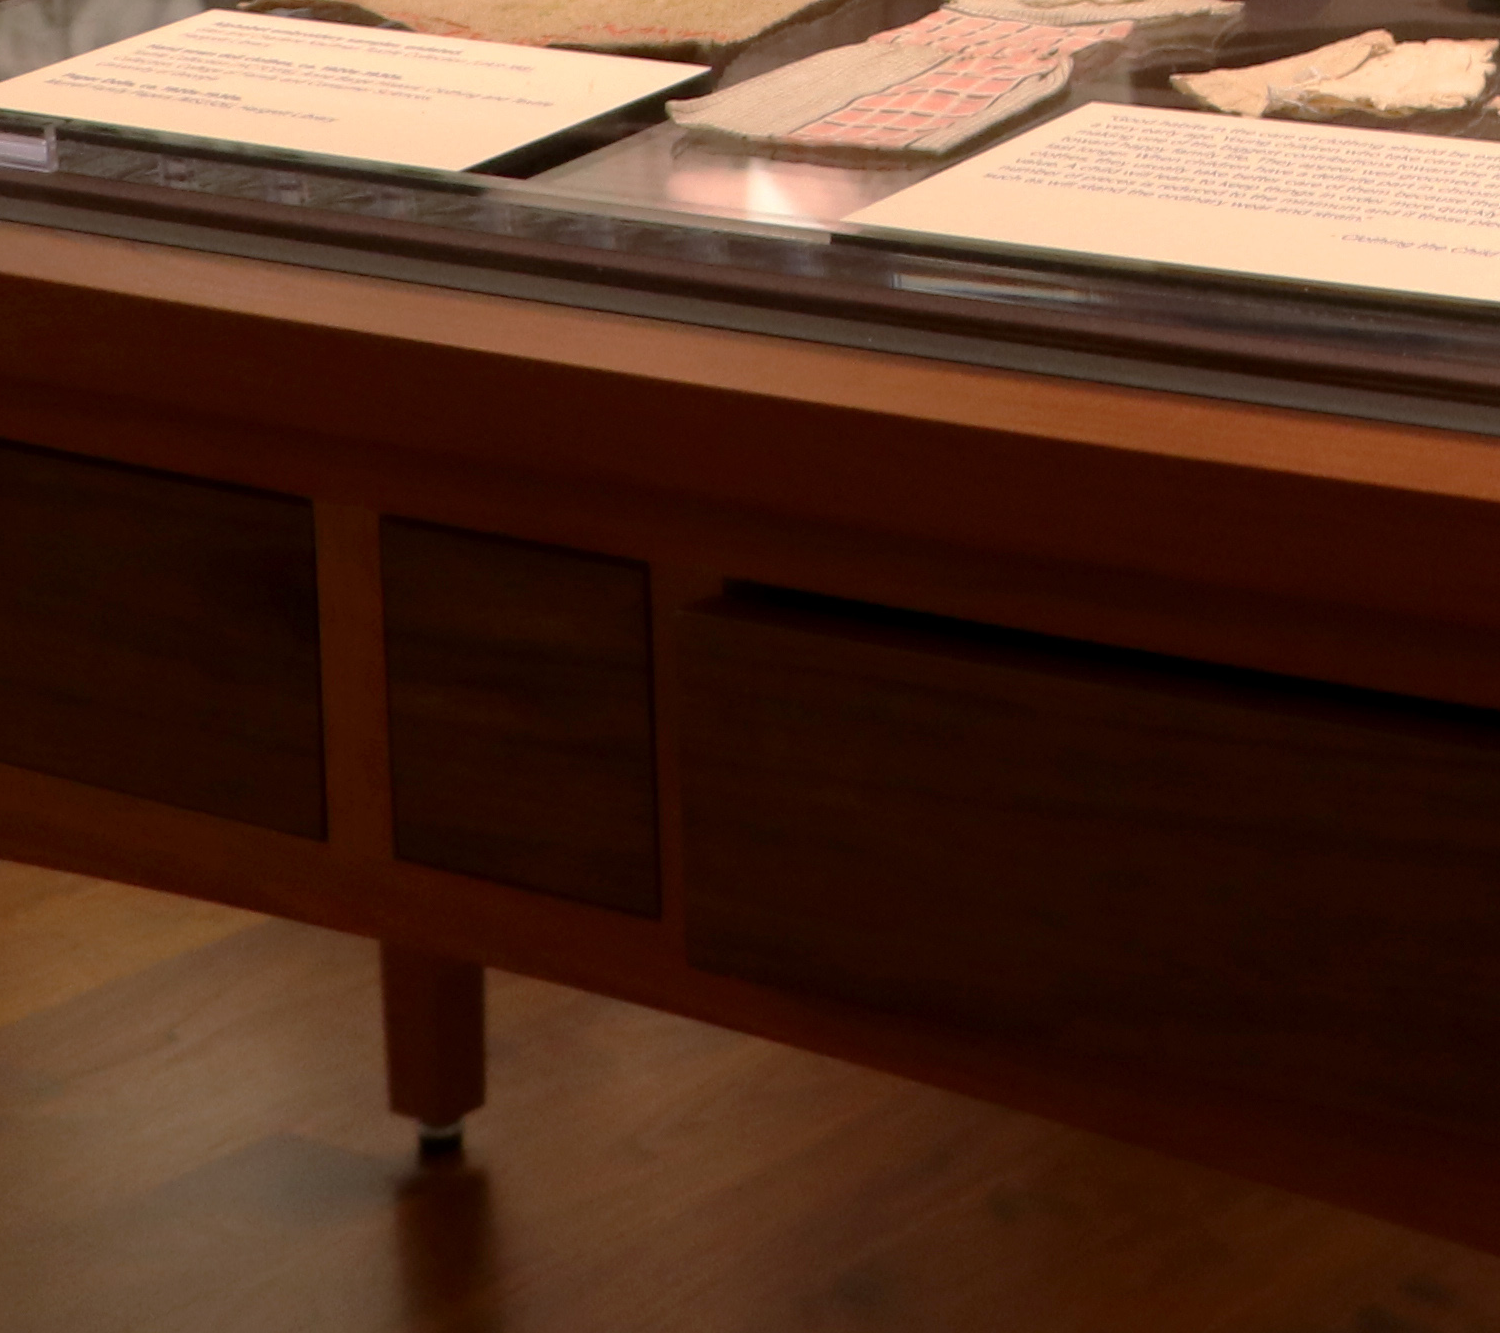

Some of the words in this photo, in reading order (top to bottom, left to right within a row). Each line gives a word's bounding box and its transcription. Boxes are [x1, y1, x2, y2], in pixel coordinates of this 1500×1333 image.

[1105, 123, 1134, 132] very
[1141, 128, 1177, 136] early
[1223, 135, 1271, 146] Young
[1274, 142, 1340, 153] children
[1384, 152, 1415, 161] take
[1423, 158, 1461, 166] care
[1159, 120, 1206, 130] habits
[1318, 138, 1384, 149] clothing
[1390, 145, 1446, 155] should
[983, 172, 1021, 181] such
[1047, 180, 1077, 188] will
[1077, 184, 1126, 194] stand
[1157, 193, 1225, 206] ordinary
[1231, 201, 1272, 210] wear
[1341, 234, 1414, 248] Clothing
[1450, 246, 1498, 257] Child
